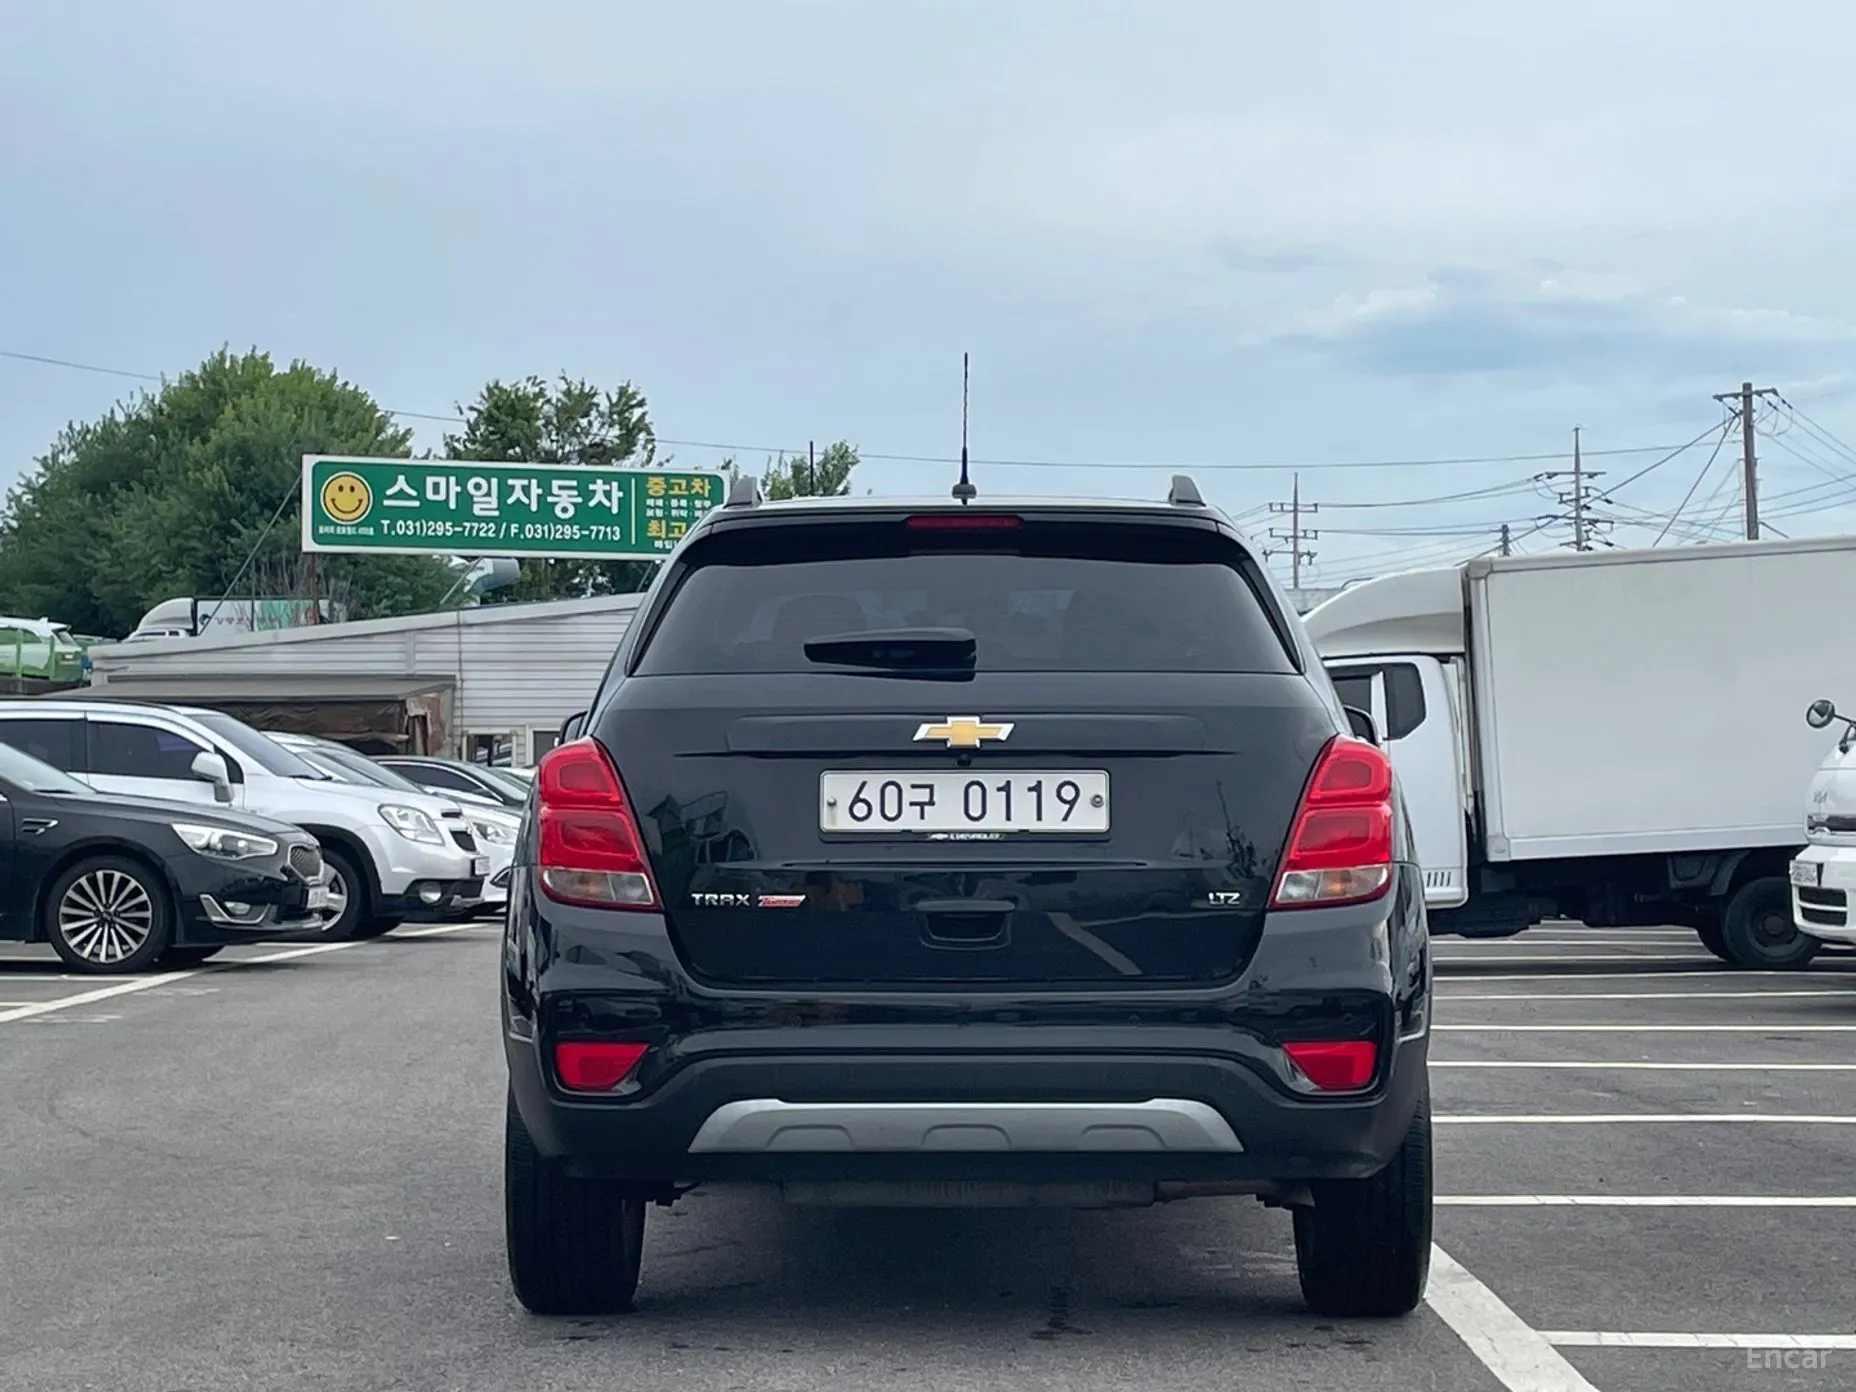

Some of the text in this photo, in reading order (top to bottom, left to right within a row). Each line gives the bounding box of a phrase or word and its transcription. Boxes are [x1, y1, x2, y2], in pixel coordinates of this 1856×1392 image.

[382, 474, 625, 520] 스마일자동차
[646, 476, 712, 498] 중고차
[381, 519, 497, 538] T.031)295-7722
[510, 523, 622, 542] F.031)295-7713
[848, 780, 1081, 823] 60구 0119
[691, 893, 750, 907] TRAX
[1208, 892, 1241, 905] LTZ
